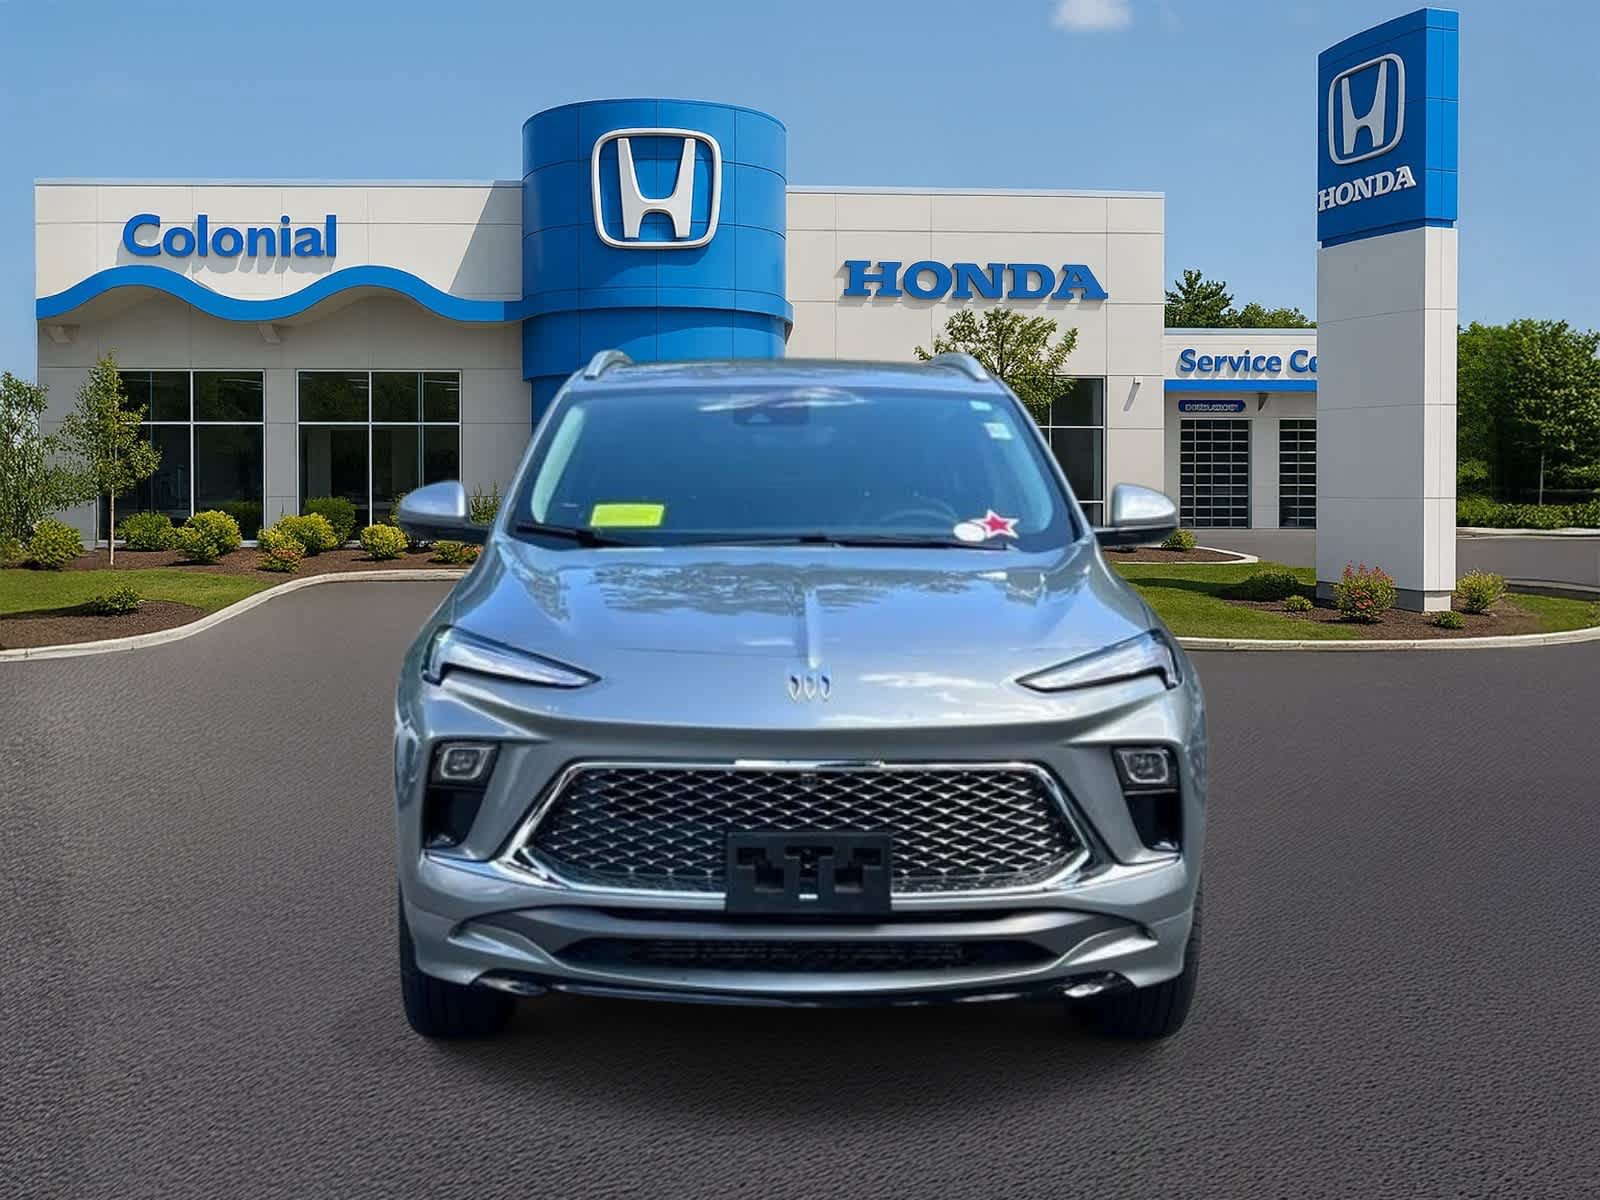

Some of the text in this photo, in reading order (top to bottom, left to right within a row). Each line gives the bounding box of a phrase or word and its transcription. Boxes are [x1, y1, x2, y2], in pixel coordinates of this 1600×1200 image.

[1318, 165, 1416, 212] HONDA
[123, 213, 337, 257] Colonial
[843, 260, 1109, 300] HONDA
[1179, 348, 1282, 373] Service
